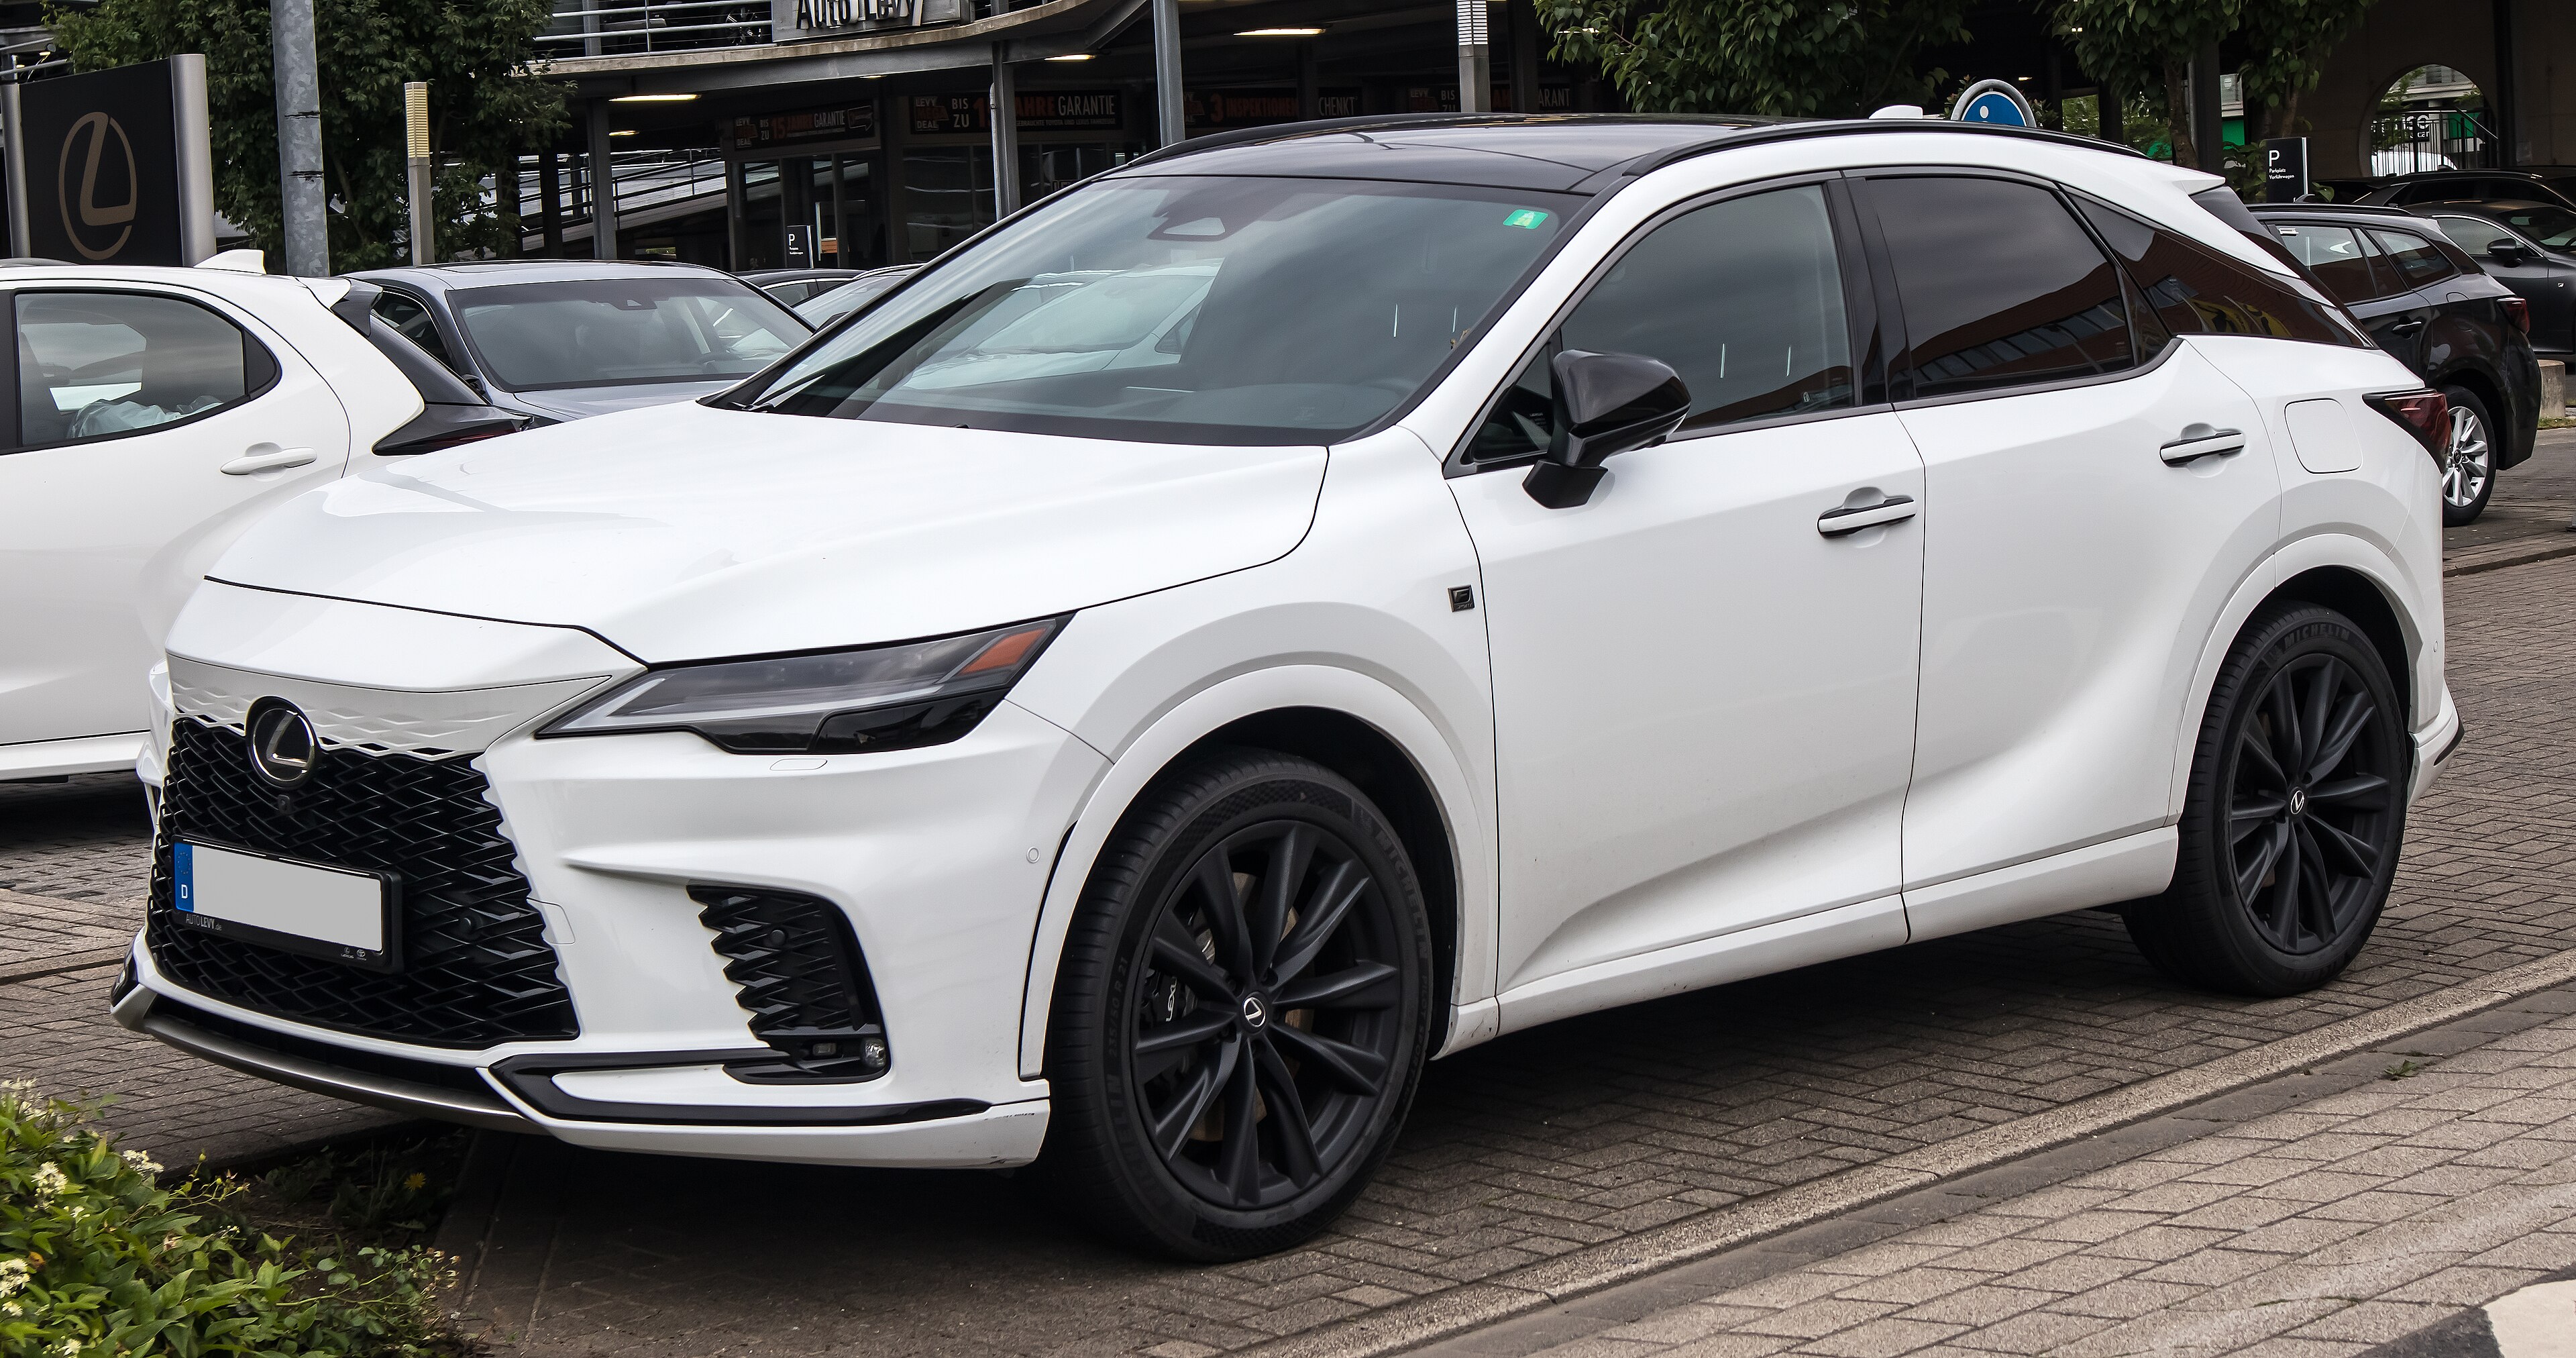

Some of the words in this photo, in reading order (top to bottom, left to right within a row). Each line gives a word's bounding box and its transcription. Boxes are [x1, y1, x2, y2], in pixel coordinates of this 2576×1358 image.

[916, 97, 937, 107] LEVY
[951, 98, 969, 110] BIS
[1441, 90, 1455, 100] BIS
[1539, 88, 1570, 107] ARANT
[1015, 95, 1056, 117] AHRE
[1057, 95, 1117, 117] GARANTIE
[1210, 92, 1224, 123] 3
[1319, 96, 1354, 116] CHENKT
[814, 110, 846, 128] GARANTIE
[917, 120, 938, 129] DEAL
[953, 113, 970, 128] ZU
[2269, 150, 2280, 167] P
[788, 233, 796, 246] P
[2284, 623, 2351, 650] MICHELIN
[181, 884, 189, 899] D
[1375, 830, 1429, 959] MICHELIN
[1118, 956, 1128, 976] 21
[1114, 980, 1124, 993] R
[1419, 975, 1428, 1017] PILOT
[1109, 997, 1120, 1057] 235/50
[1409, 1025, 1425, 1078] SPORT
